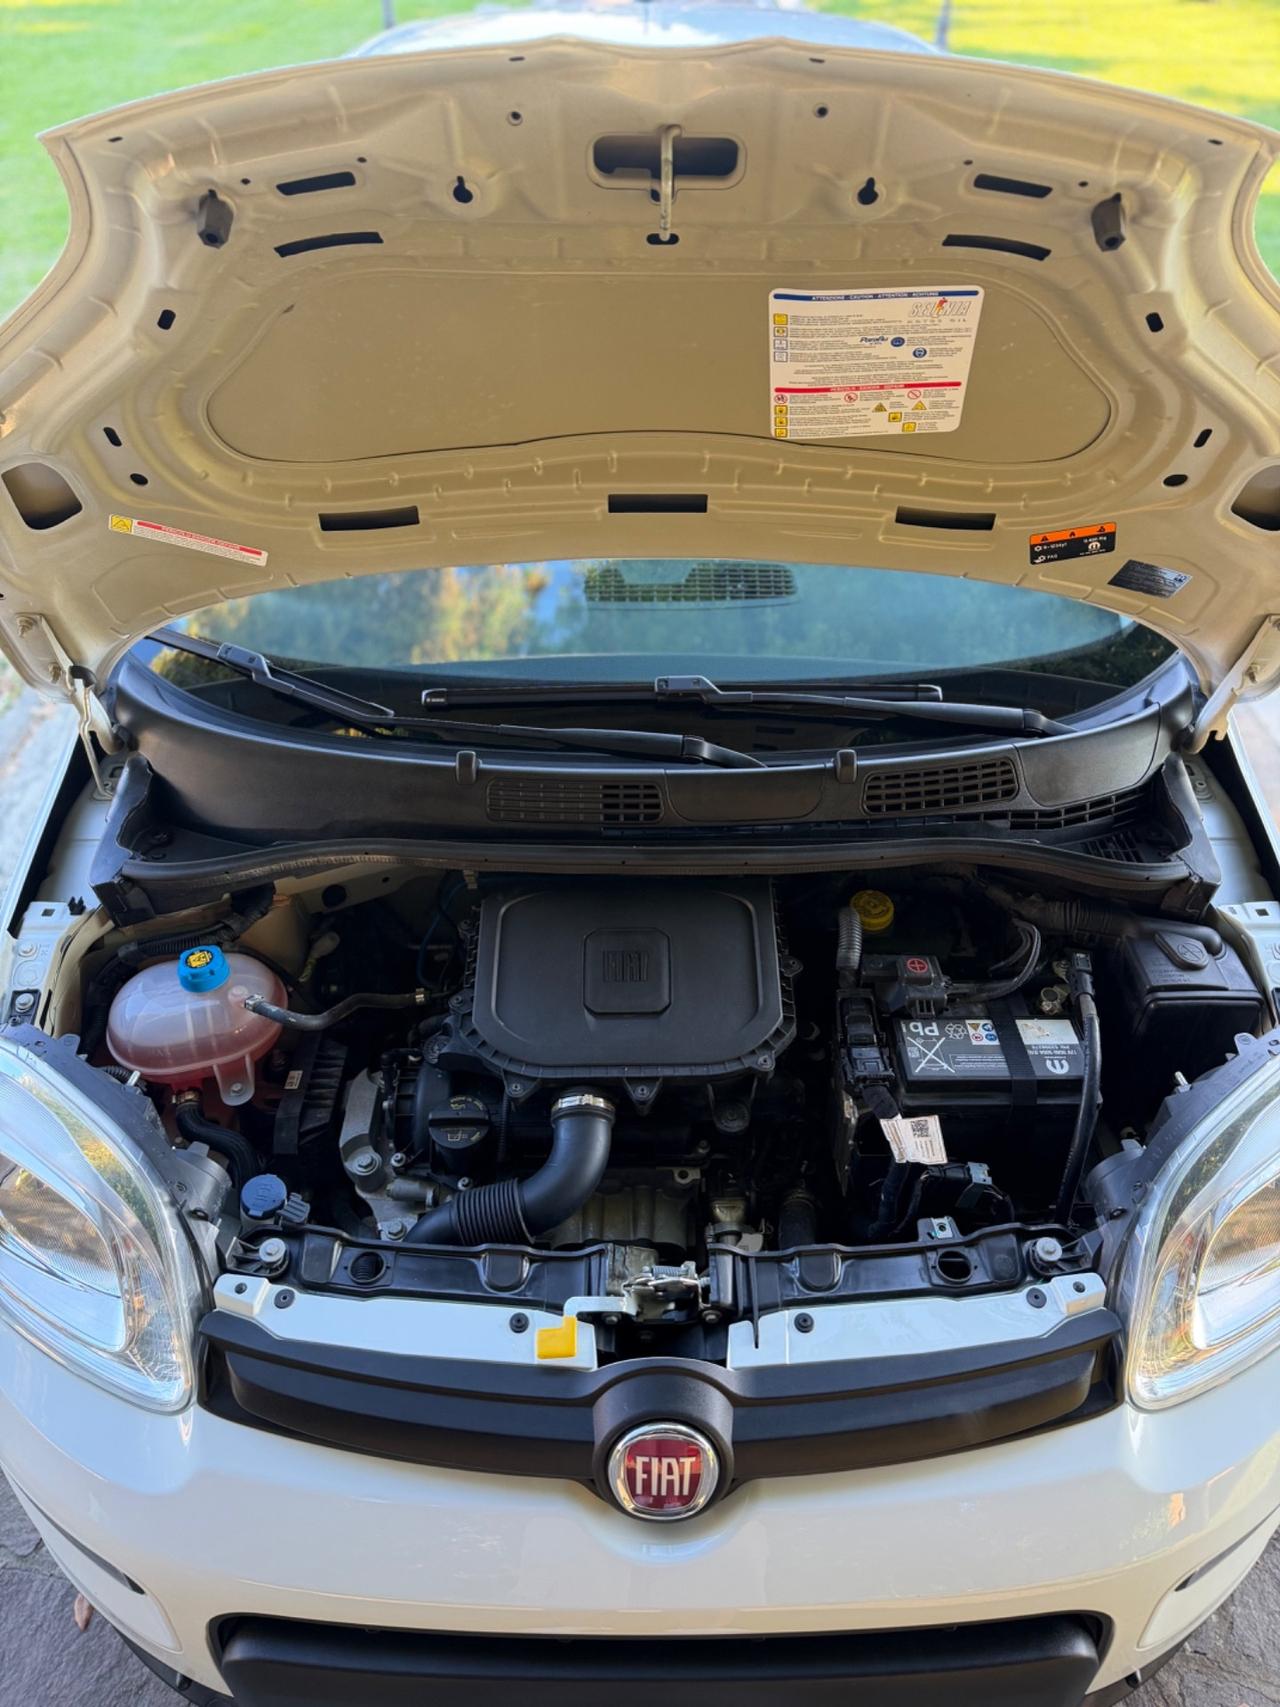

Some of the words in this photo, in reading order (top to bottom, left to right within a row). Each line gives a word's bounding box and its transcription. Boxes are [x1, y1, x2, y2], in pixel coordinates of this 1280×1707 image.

[908, 299, 971, 318] SELNIA
[909, 1022, 940, 1036] Pb
[635, 1456, 696, 1496] FIAT
